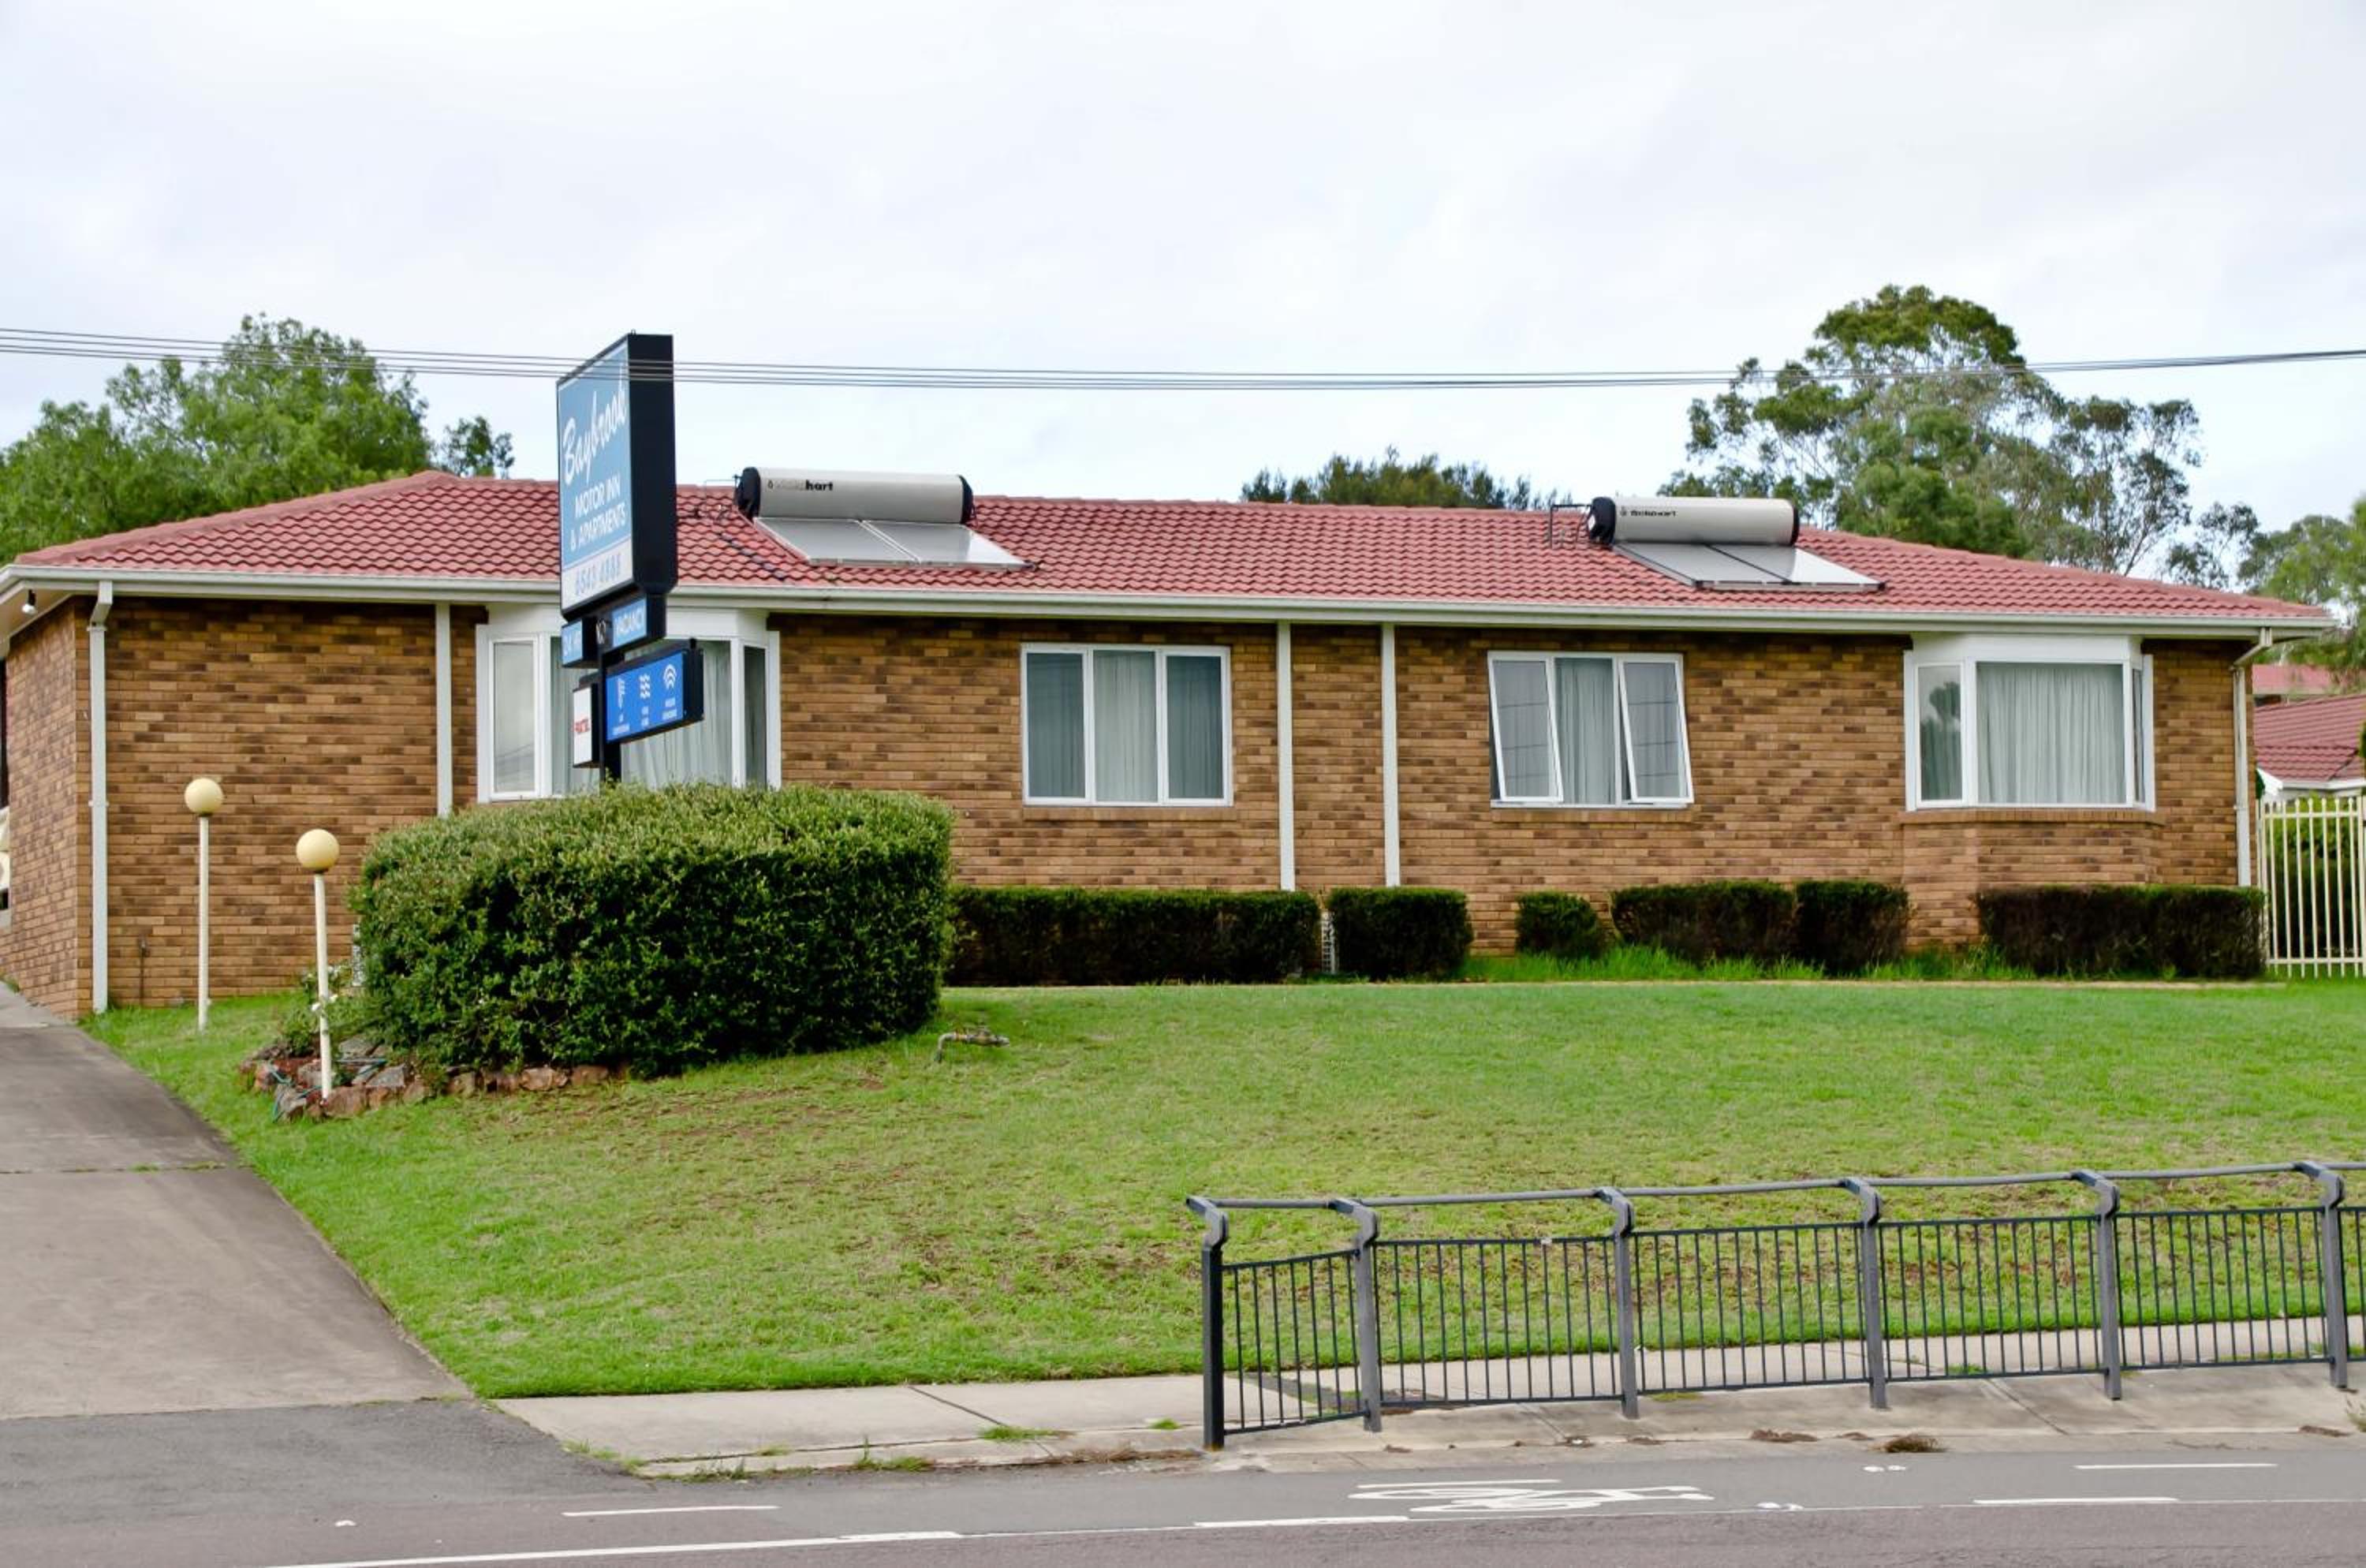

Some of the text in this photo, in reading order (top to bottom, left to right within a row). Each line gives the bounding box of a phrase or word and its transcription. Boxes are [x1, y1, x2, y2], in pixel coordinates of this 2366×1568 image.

[563, 364, 627, 486] Baybrook
[575, 473, 621, 517] MOTOR INN
[578, 502, 626, 549] APARTMENTS
